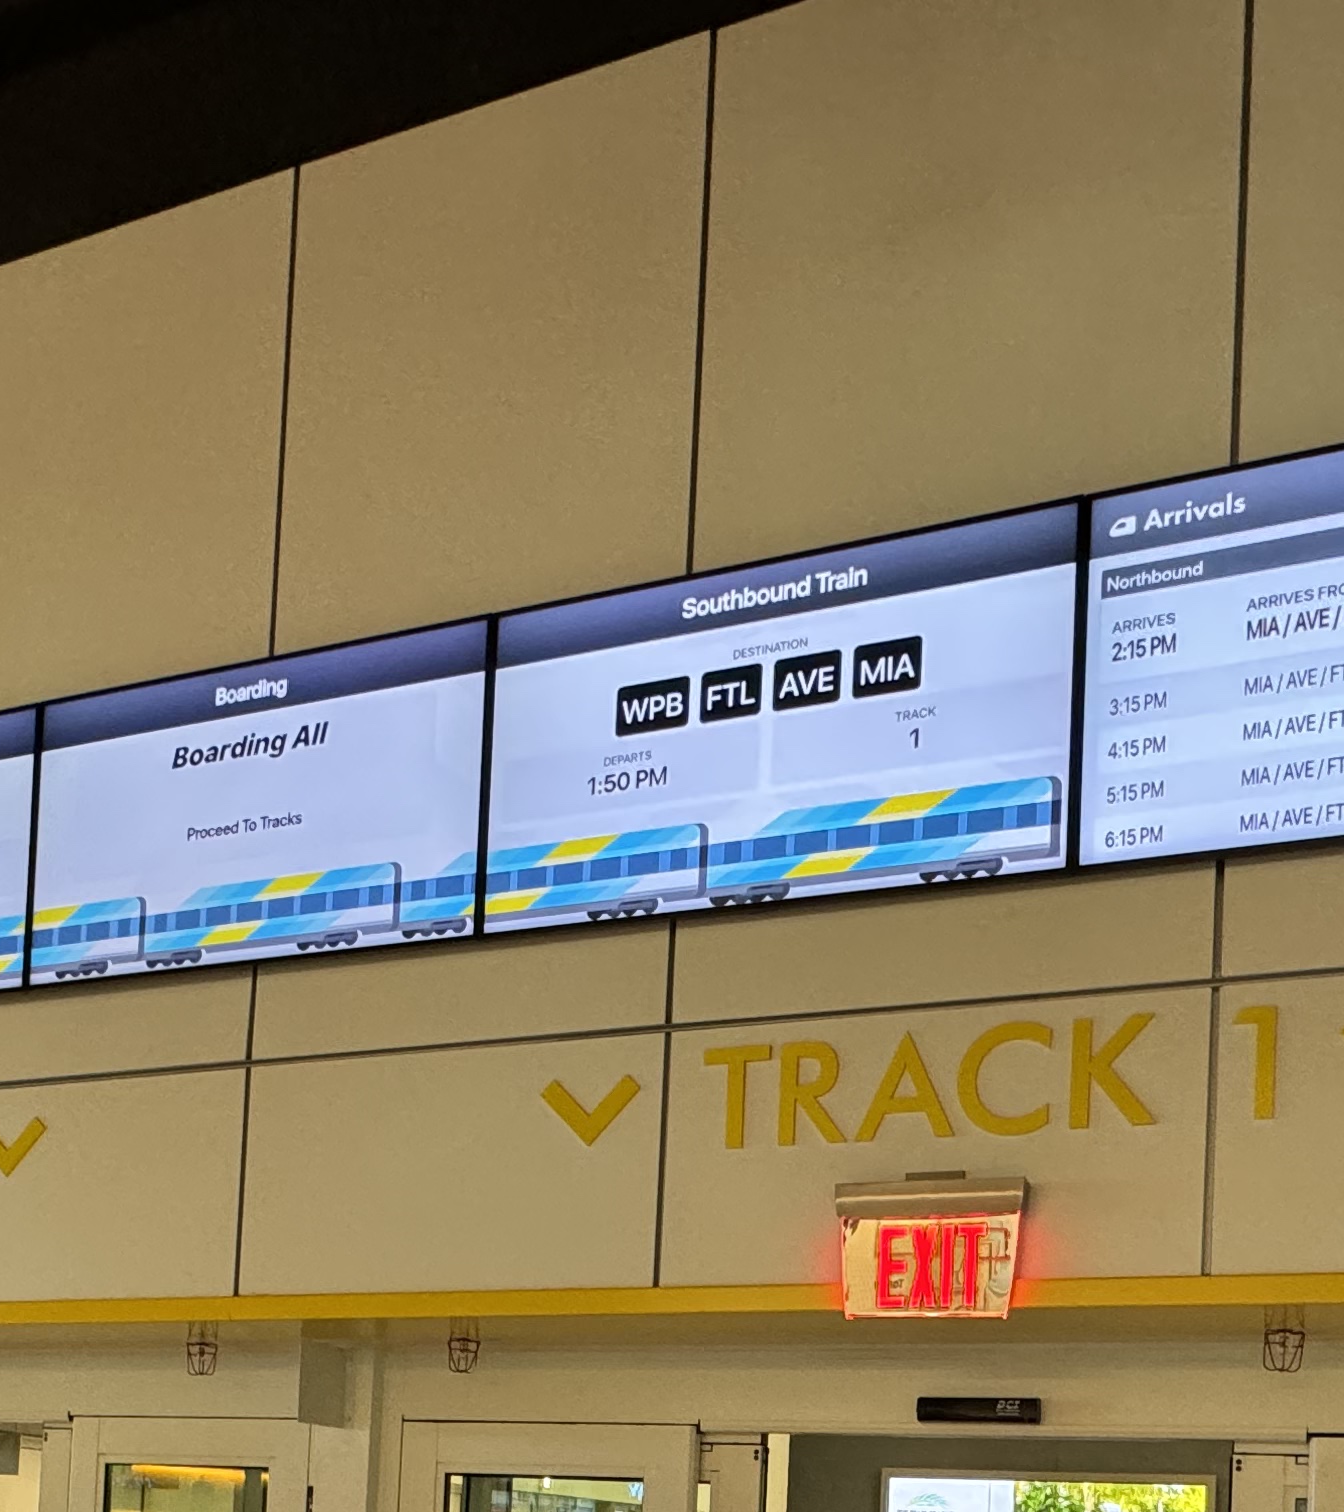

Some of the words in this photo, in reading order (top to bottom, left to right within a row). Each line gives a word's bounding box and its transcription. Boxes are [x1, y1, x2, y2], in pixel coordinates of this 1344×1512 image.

[1144, 492, 1246, 531] Arrivals
[1107, 561, 1203, 593] Northbound
[682, 576, 810, 618] Southbound
[816, 567, 868, 593] Train
[1246, 587, 1314, 612] ARRIVES
[1112, 612, 1176, 634] ARRIVES
[1246, 617, 1280, 641] MIA
[1295, 607, 1330, 634] AVE
[733, 637, 809, 660] DESTINATION
[1112, 637, 1146, 662] 2:15
[1150, 633, 1177, 655] PM
[215, 678, 287, 706] Boarding
[622, 692, 683, 725] WPB
[706, 680, 755, 710] FTL
[779, 666, 835, 699] AVE
[860, 654, 915, 686] MIA
[1244, 676, 1273, 696] MIA
[1286, 667, 1318, 689] AVE
[895, 706, 936, 722] TRACK
[1109, 695, 1140, 716] 3:15
[1144, 691, 1167, 711] PM
[909, 728, 919, 748] 1
[1243, 721, 1272, 741] MIA
[1284, 713, 1316, 735] AVE
[171, 731, 287, 769] Boarding
[291, 722, 328, 749] All
[603, 750, 652, 767] DEPARTS
[1108, 740, 1139, 758] 4:15
[1142, 735, 1166, 754] PM
[587, 772, 630, 795] 1:50
[635, 766, 667, 789] PM
[1241, 767, 1270, 786] MIA
[1283, 759, 1314, 780] AVE
[1107, 785, 1138, 804] 5:15
[1141, 780, 1164, 800] PM
[187, 821, 239, 841] Proceed
[243, 819, 257, 833] To
[261, 812, 302, 831] Tracks
[1240, 813, 1269, 832] MIA
[1282, 805, 1313, 826] AVE
[1105, 829, 1136, 848] 6:15
[1139, 825, 1163, 844] PM
[702, 1011, 1157, 1150] TRACK
[1233, 1005, 1278, 1121] 1
[877, 1223, 988, 1308] EXIT
